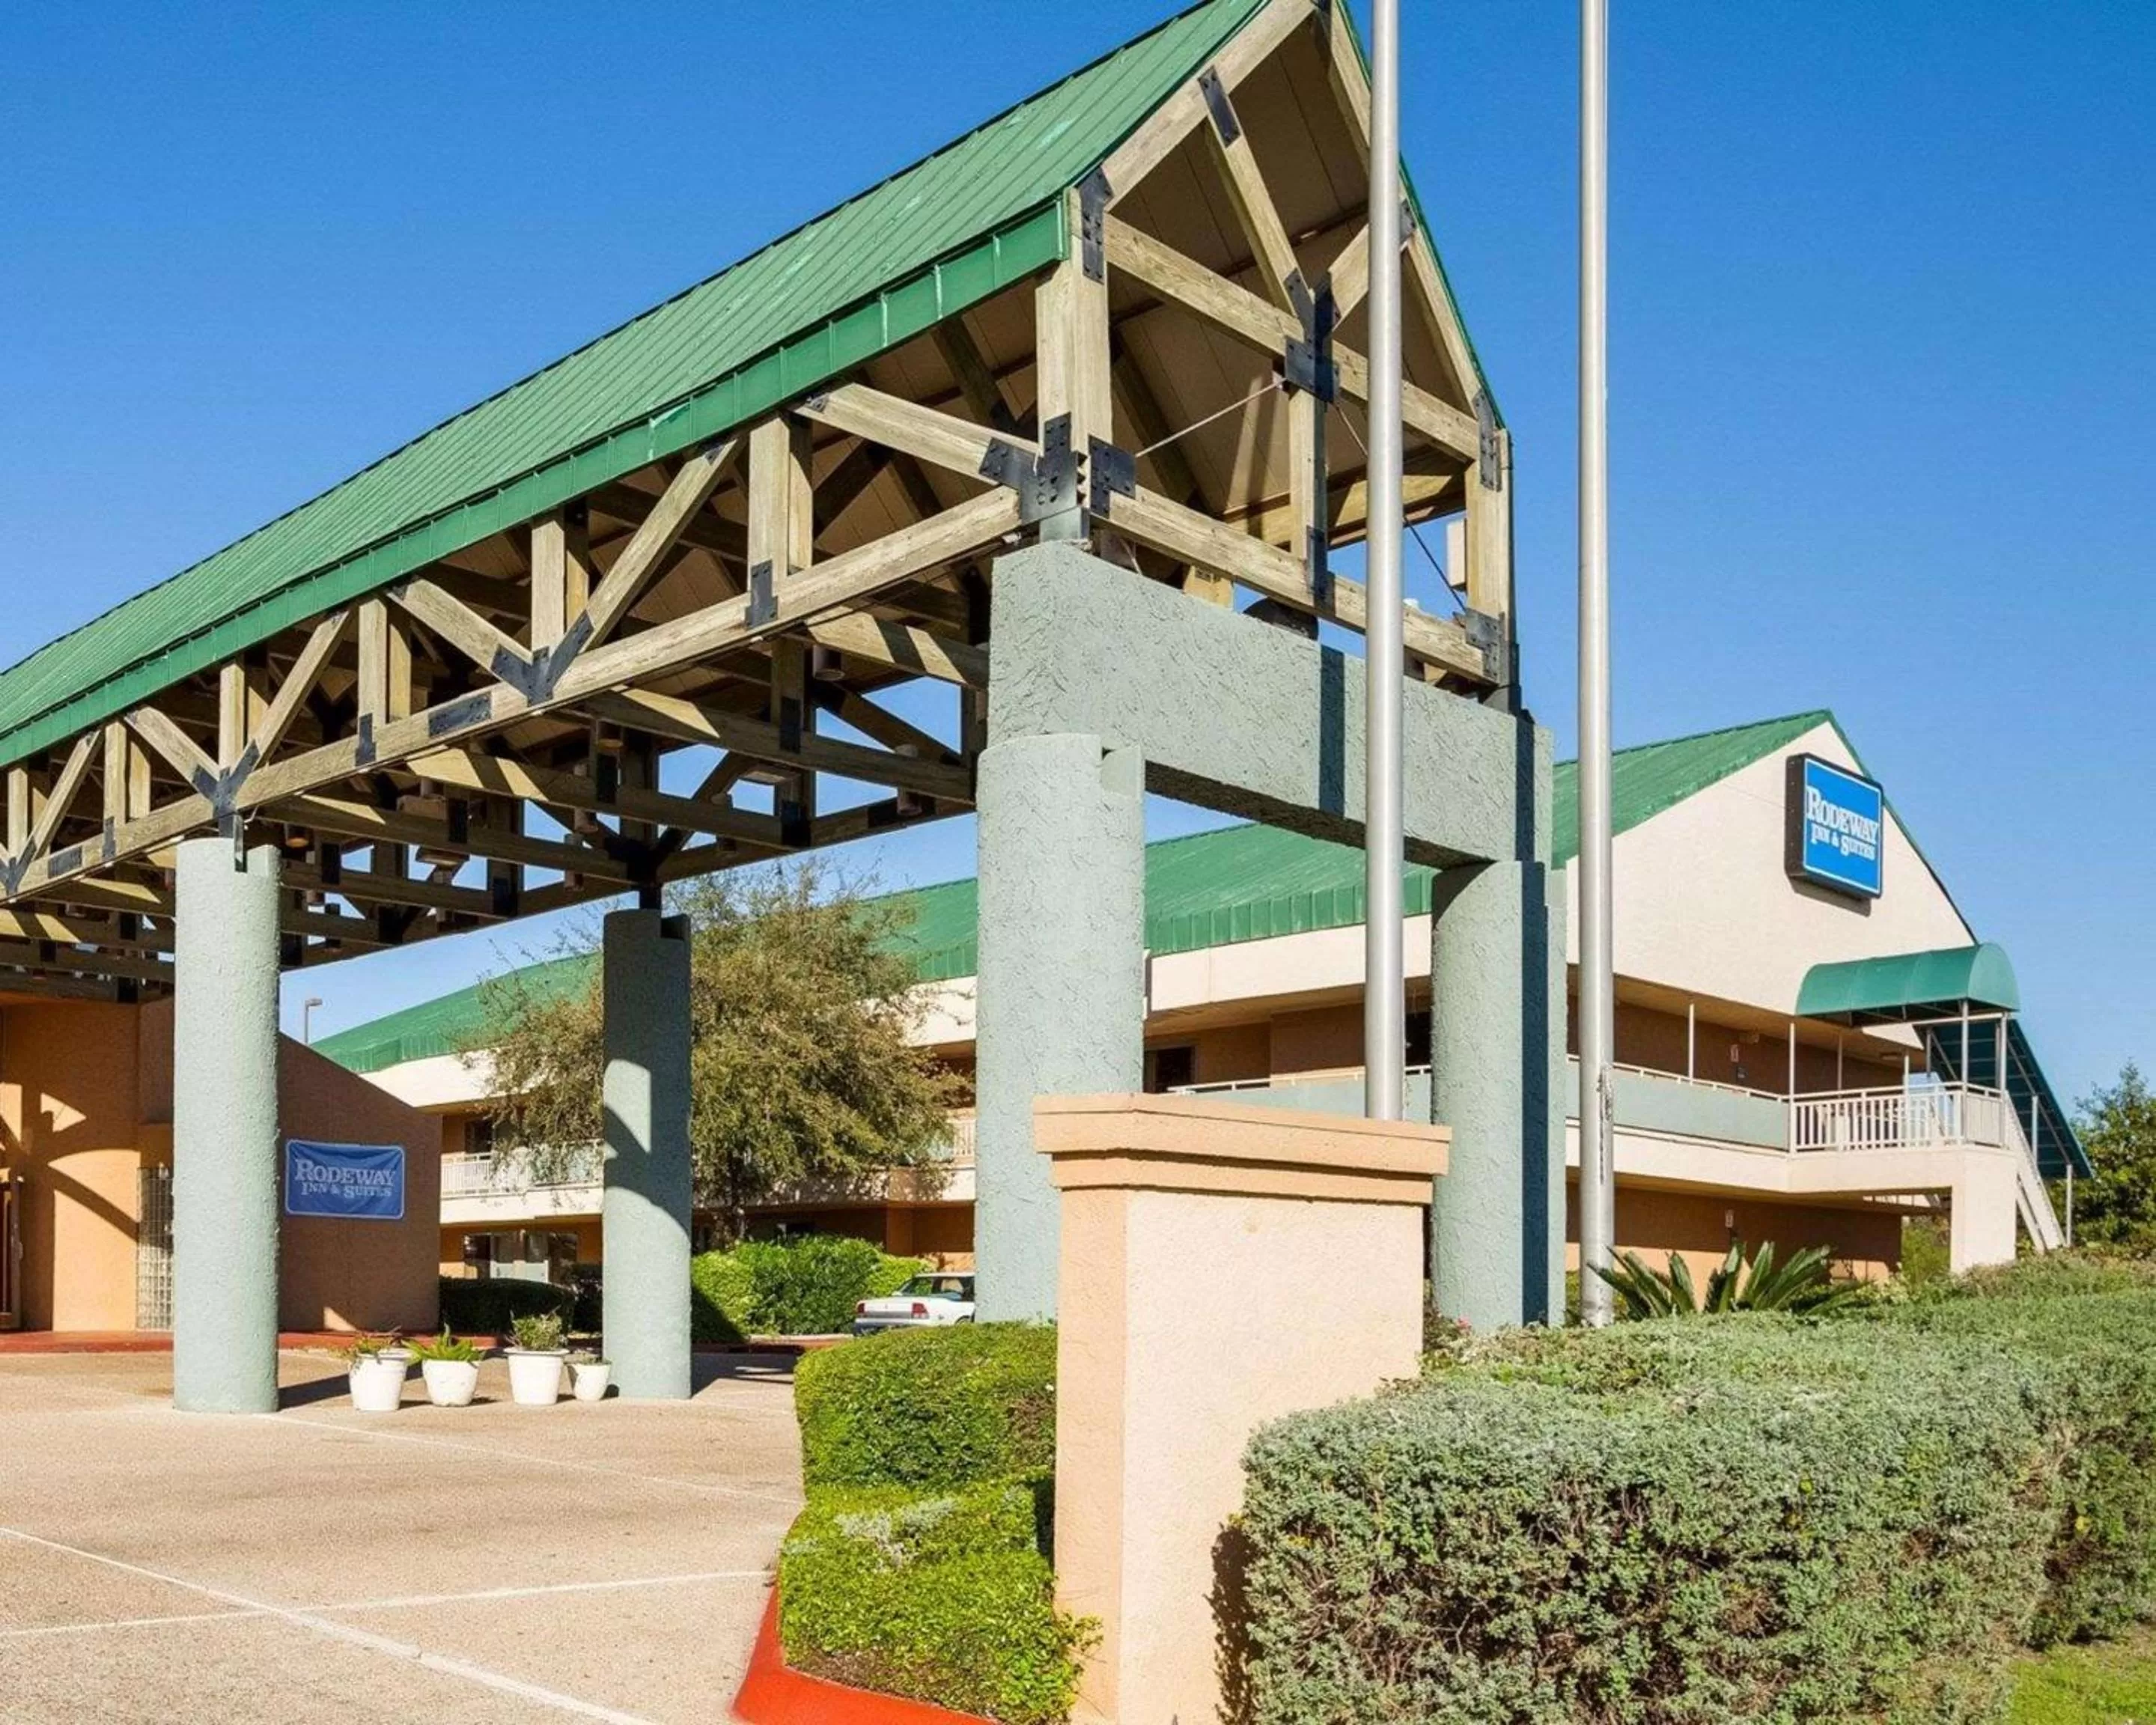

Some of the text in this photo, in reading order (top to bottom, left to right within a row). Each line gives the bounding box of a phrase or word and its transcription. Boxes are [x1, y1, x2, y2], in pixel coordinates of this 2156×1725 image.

[1806, 785, 1878, 845] RODEWAY
[294, 1158, 396, 1187] RODEWAY
[301, 1182, 392, 1199] INN & SUITES
